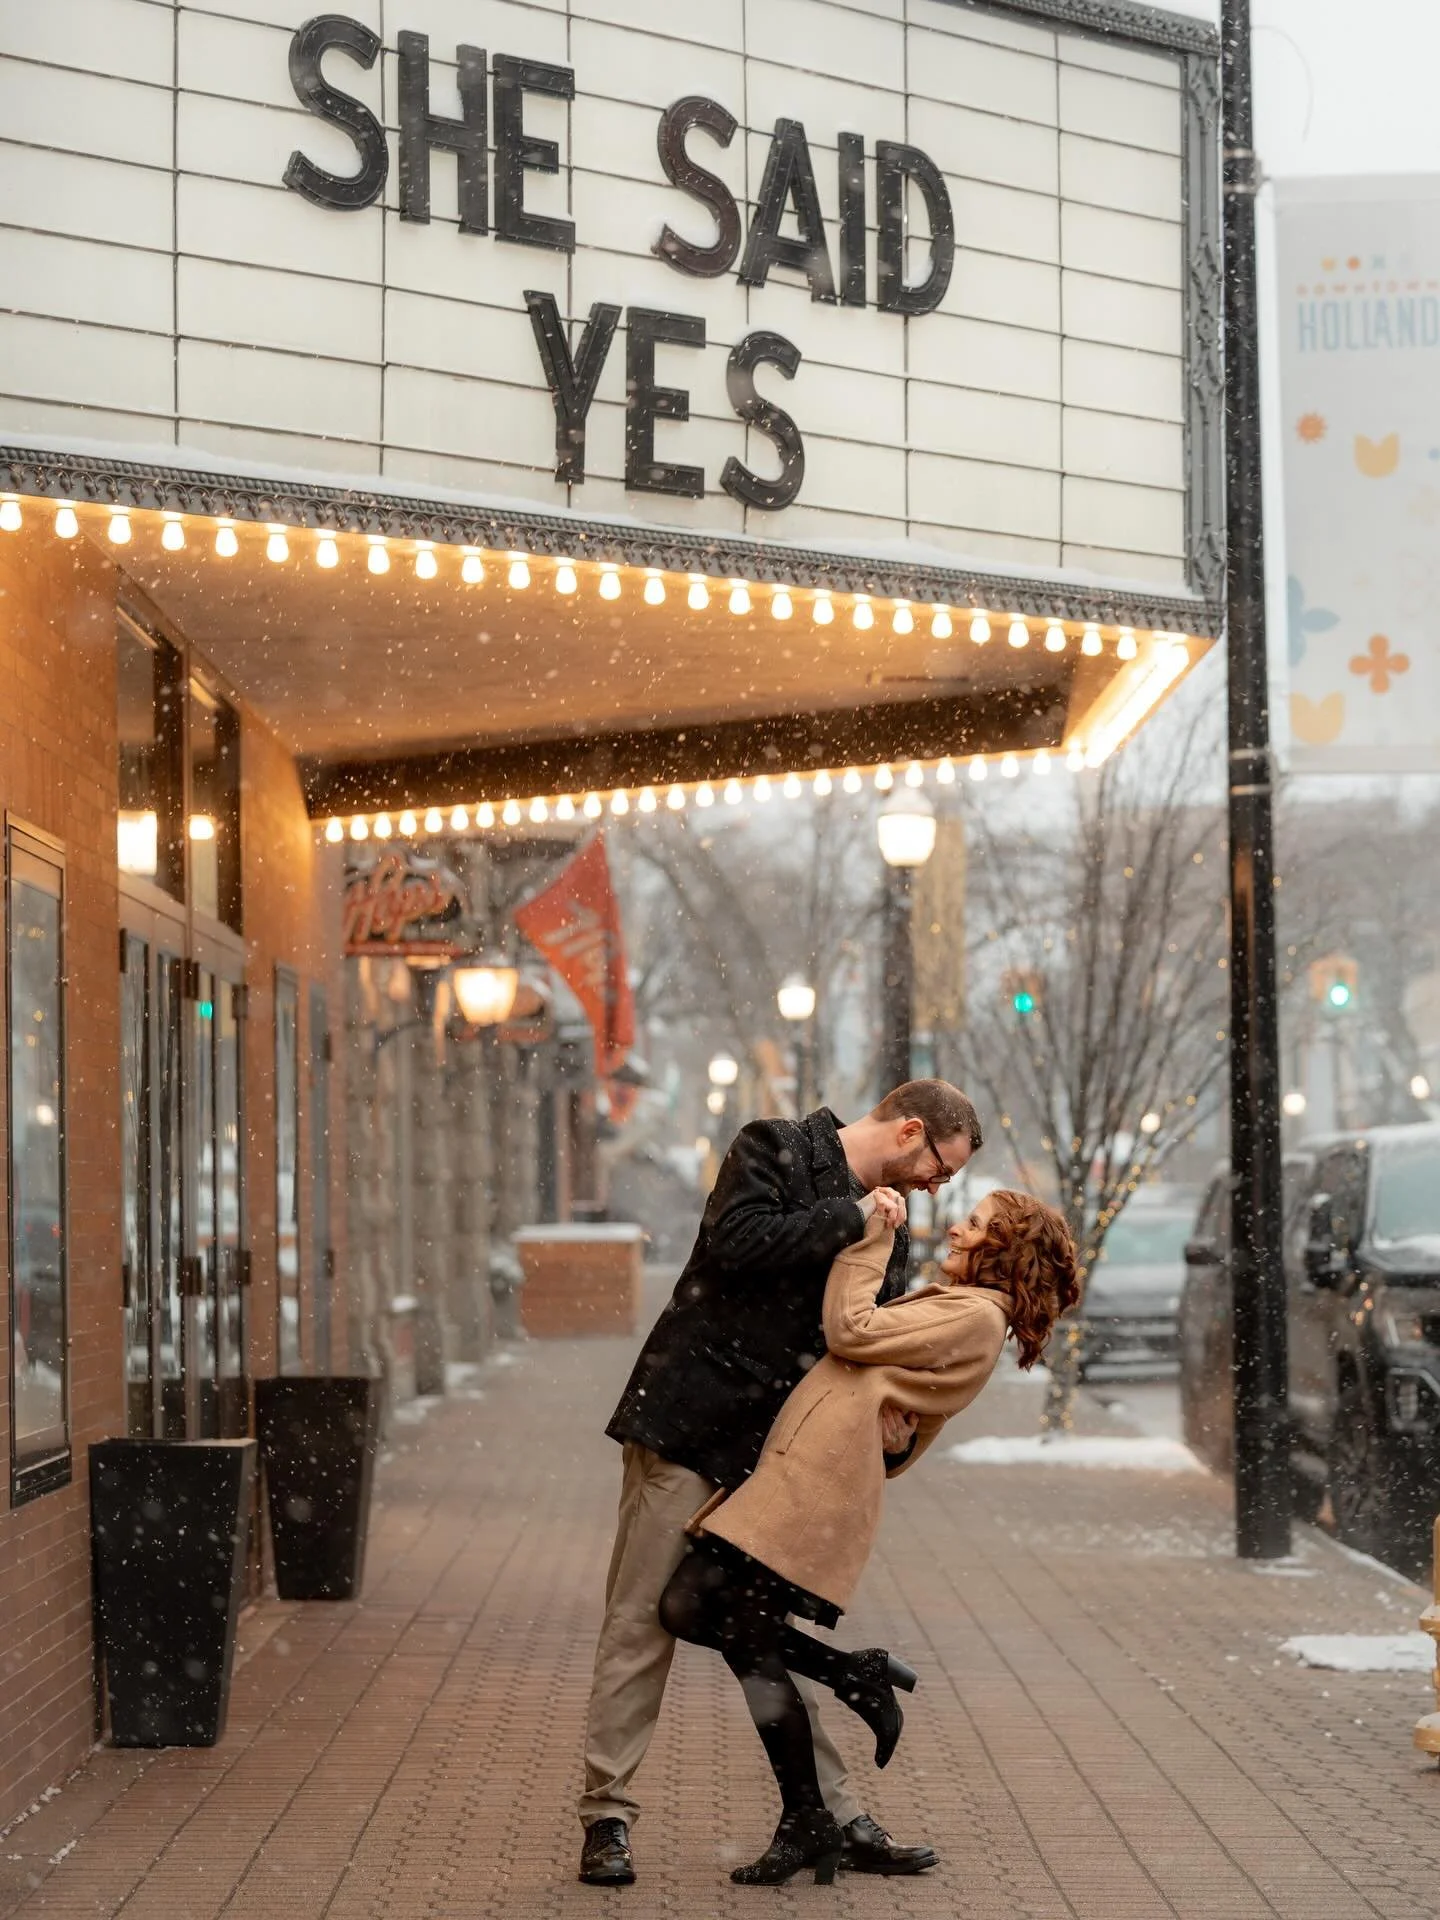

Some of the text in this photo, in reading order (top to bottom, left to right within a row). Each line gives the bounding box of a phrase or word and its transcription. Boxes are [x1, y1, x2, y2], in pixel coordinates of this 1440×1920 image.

[283, 15, 955, 317] SHE SAID
[523, 289, 804, 511] YES
[1297, 297, 1439, 353] HOLLAND
